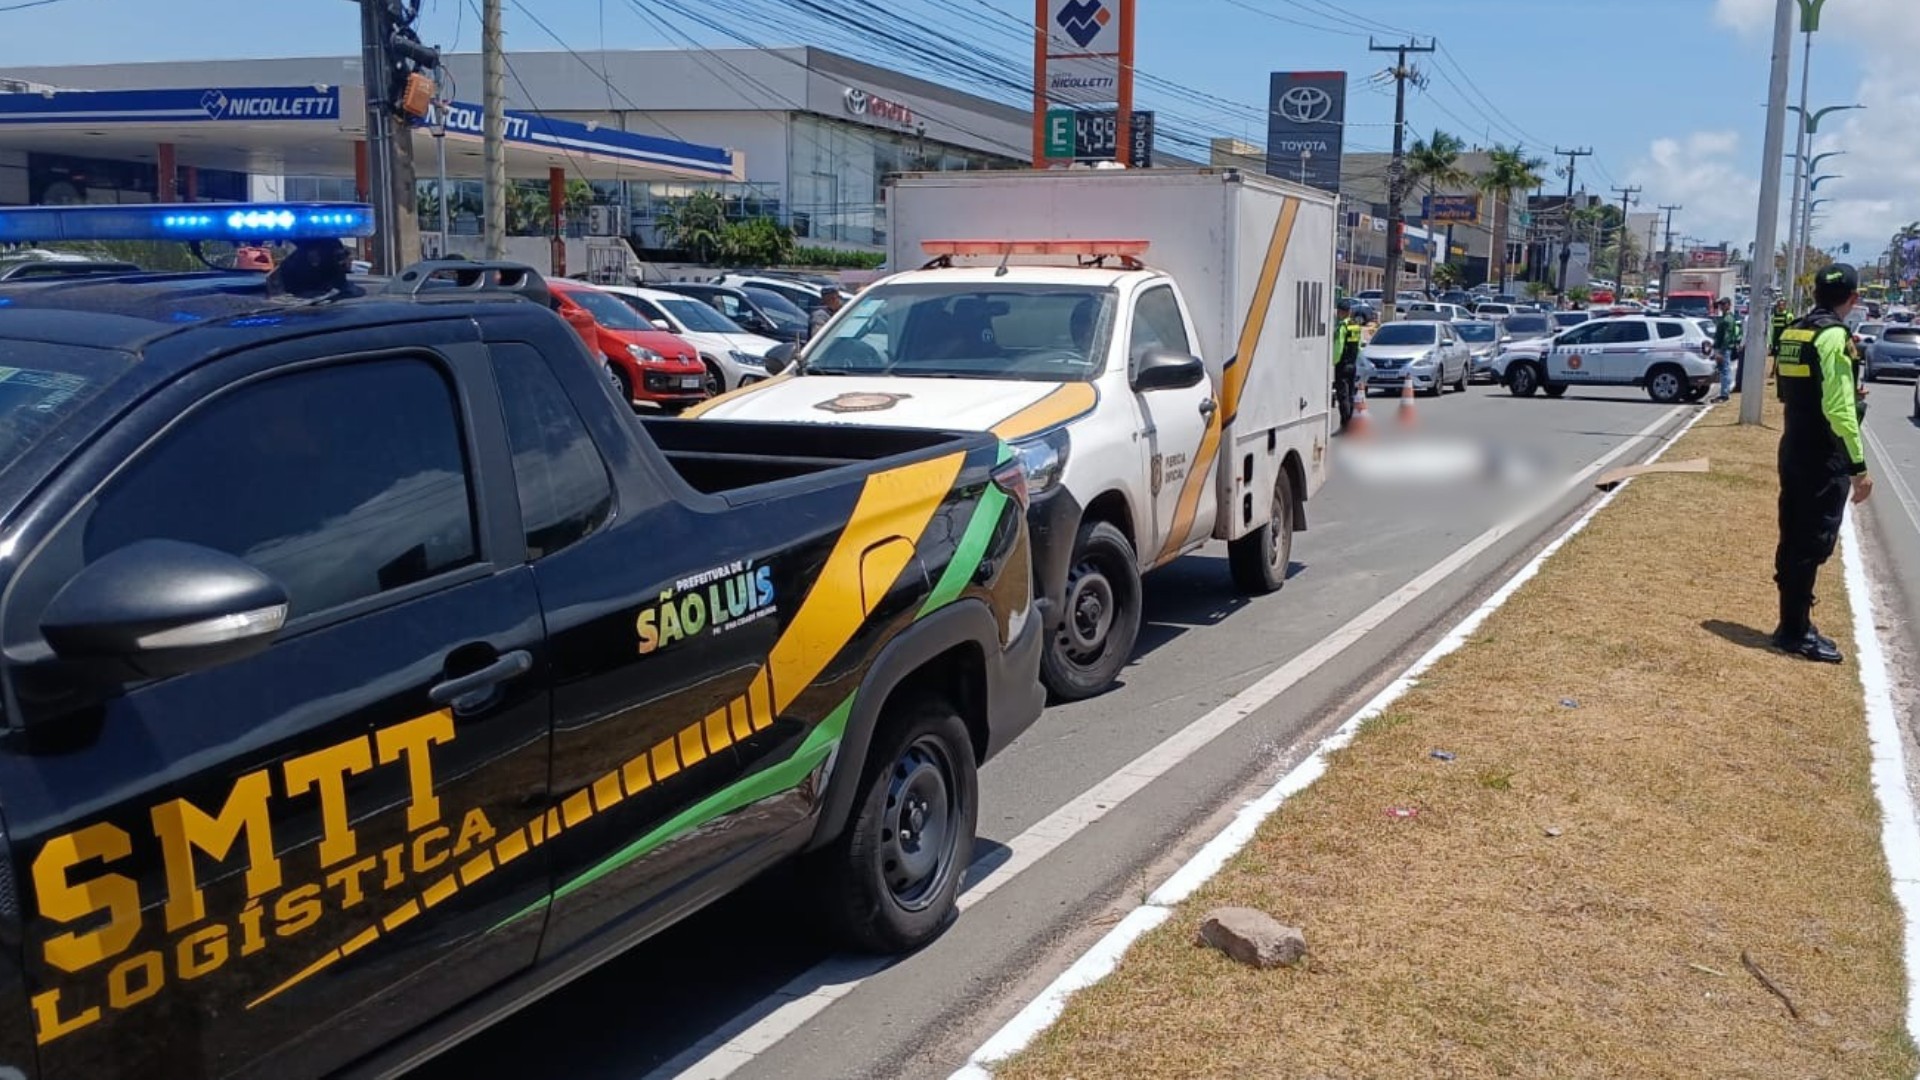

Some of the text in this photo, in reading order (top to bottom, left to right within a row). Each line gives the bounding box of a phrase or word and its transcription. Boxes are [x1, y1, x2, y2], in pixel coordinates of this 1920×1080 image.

[1051, 78, 1113, 88] NICOLLETTI
[229, 97, 333, 116] NICOLLETTI
[425, 104, 528, 138] NCOLTTI
[1052, 117, 1068, 145] E
[1076, 118, 1116, 153] 4,99
[1280, 141, 1327, 152] TOYOTA
[1295, 281, 1326, 338] IML
[676, 560, 742, 592] PREFEITURA DE
[636, 559, 774, 654] SÃO LUÍS
[32, 707, 456, 973] SMTT
[31, 808, 496, 1046] LOGÍSTICA
